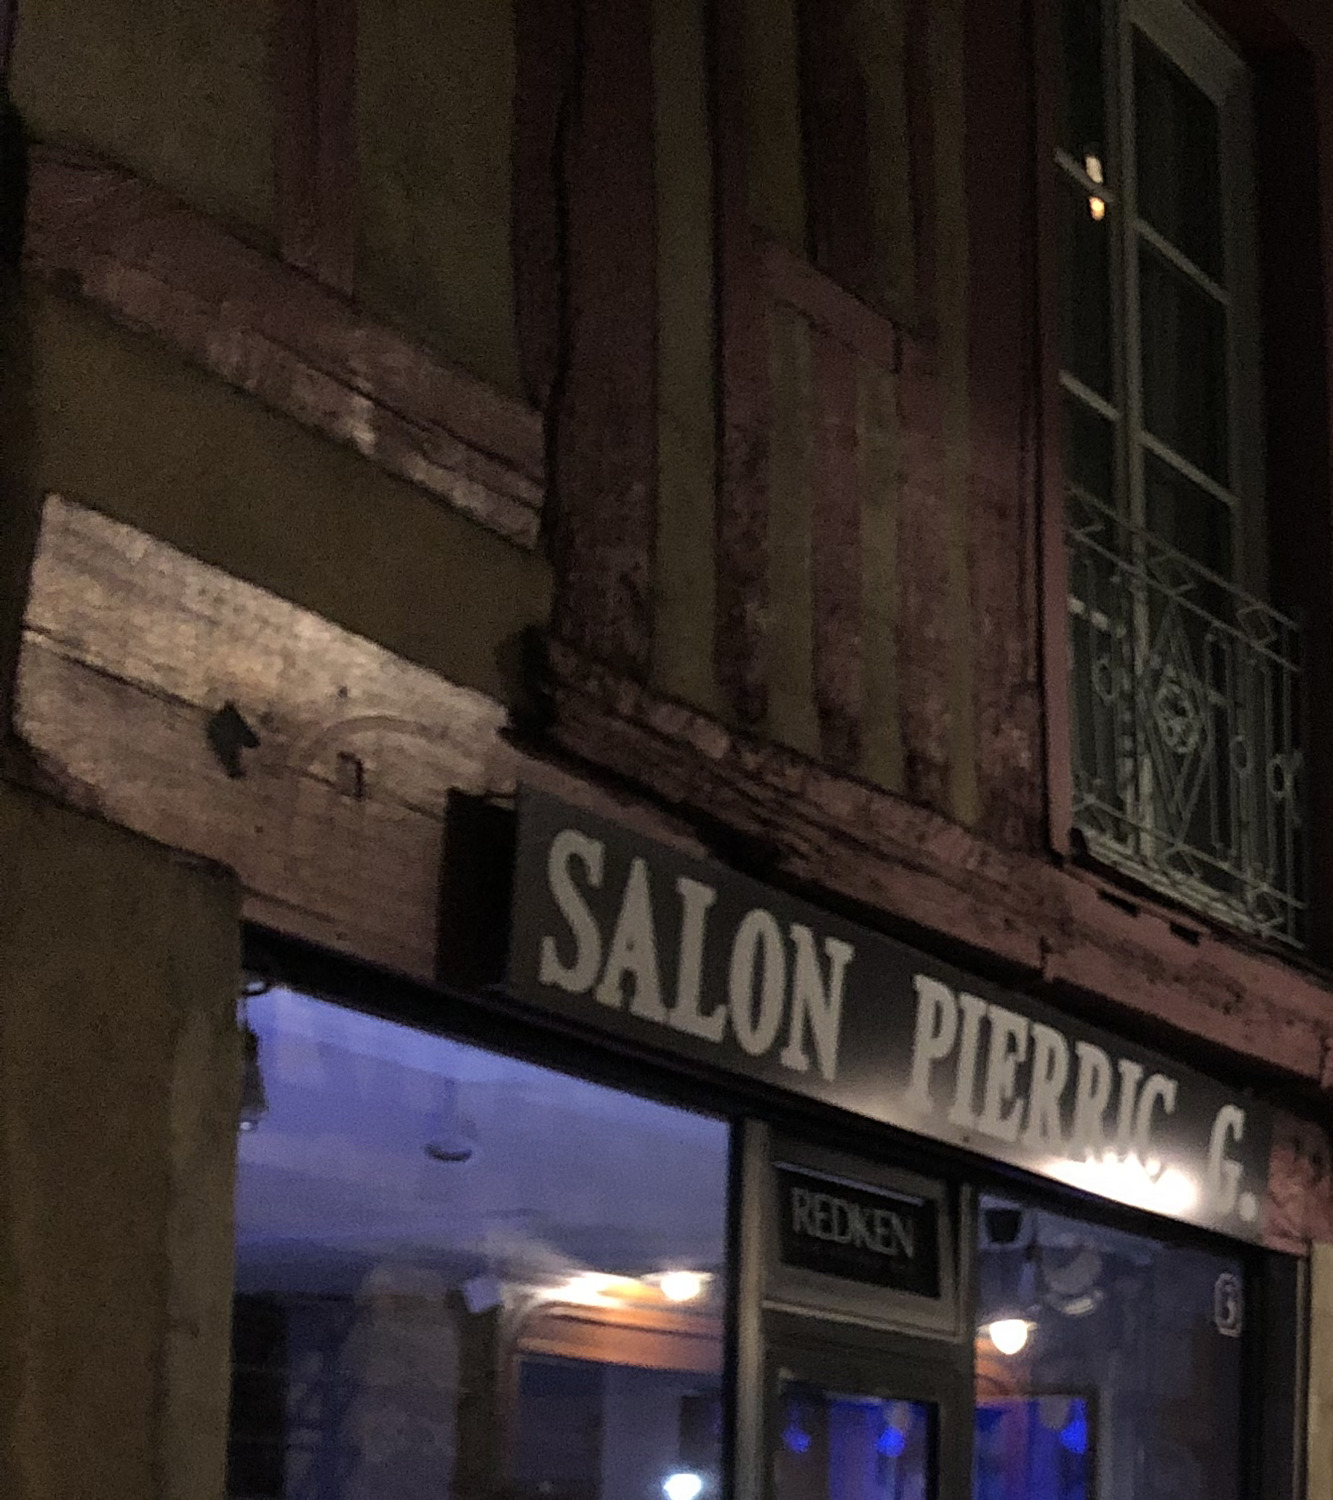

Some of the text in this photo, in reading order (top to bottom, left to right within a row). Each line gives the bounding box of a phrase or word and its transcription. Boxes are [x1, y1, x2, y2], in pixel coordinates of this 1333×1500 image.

[538, 828, 1258, 1222] SALON PIERRIC G.
[790, 1186, 914, 1260] REDKEN
